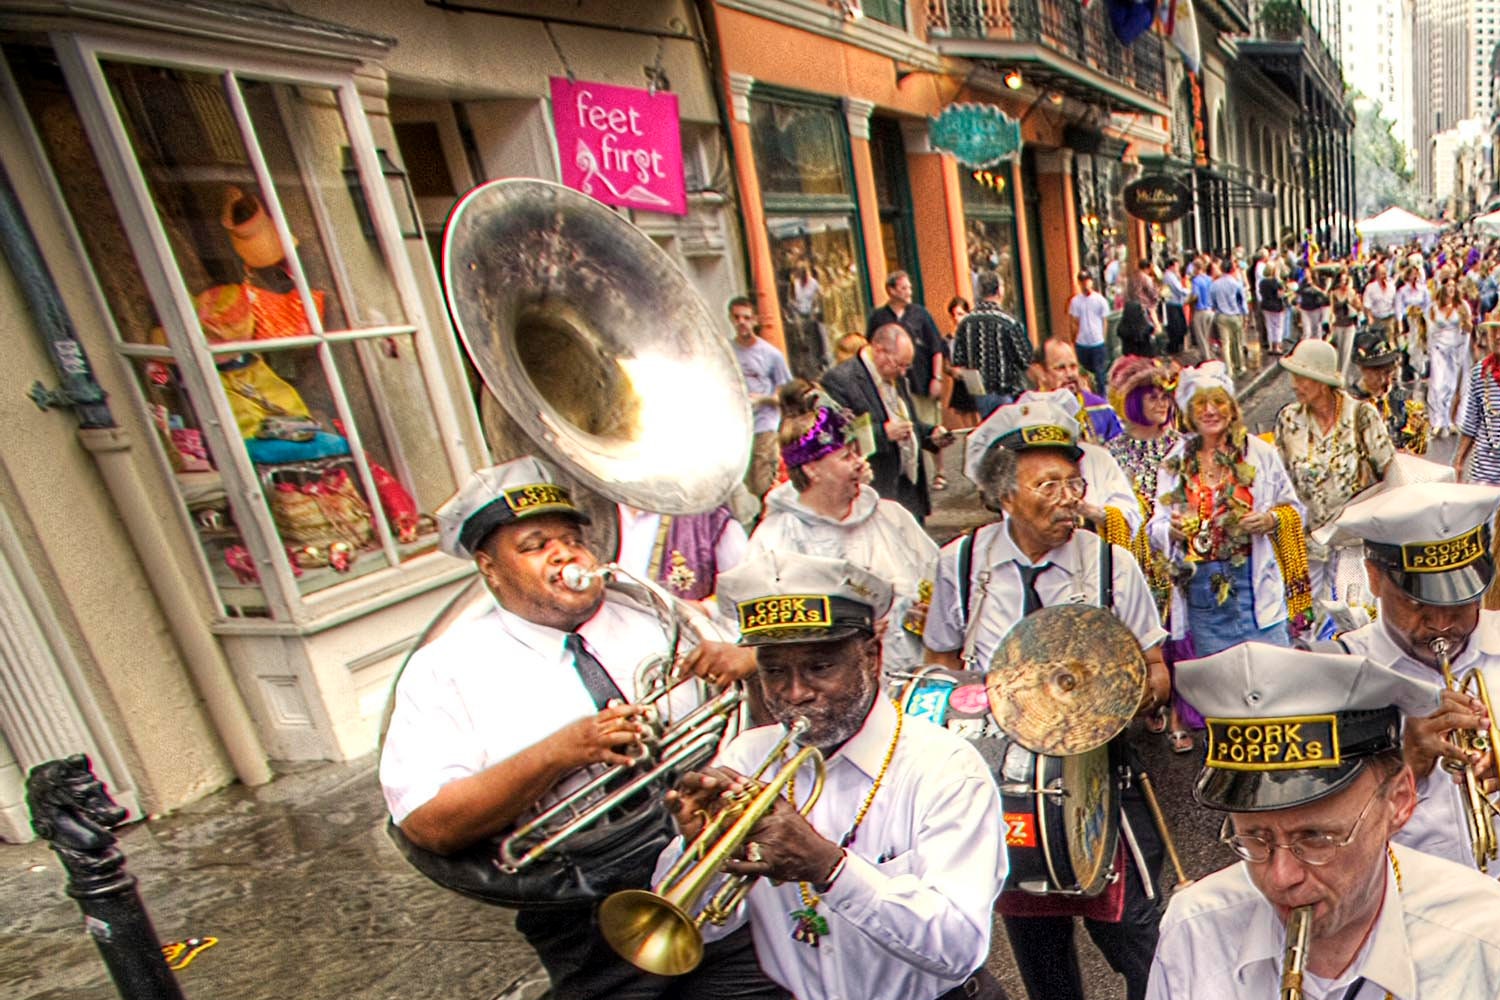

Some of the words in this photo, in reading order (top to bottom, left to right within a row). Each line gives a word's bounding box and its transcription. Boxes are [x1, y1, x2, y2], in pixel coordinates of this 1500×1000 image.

[577, 90, 644, 136] feet
[601, 133, 666, 184] first
[1413, 543, 1478, 567] POPPAS
[1423, 536, 1470, 556] CORK
[755, 598, 808, 614] CORK
[747, 610, 821, 627] POPPAS
[1227, 723, 1303, 744] CORK
[1217, 740, 1323, 762] POPPAS
